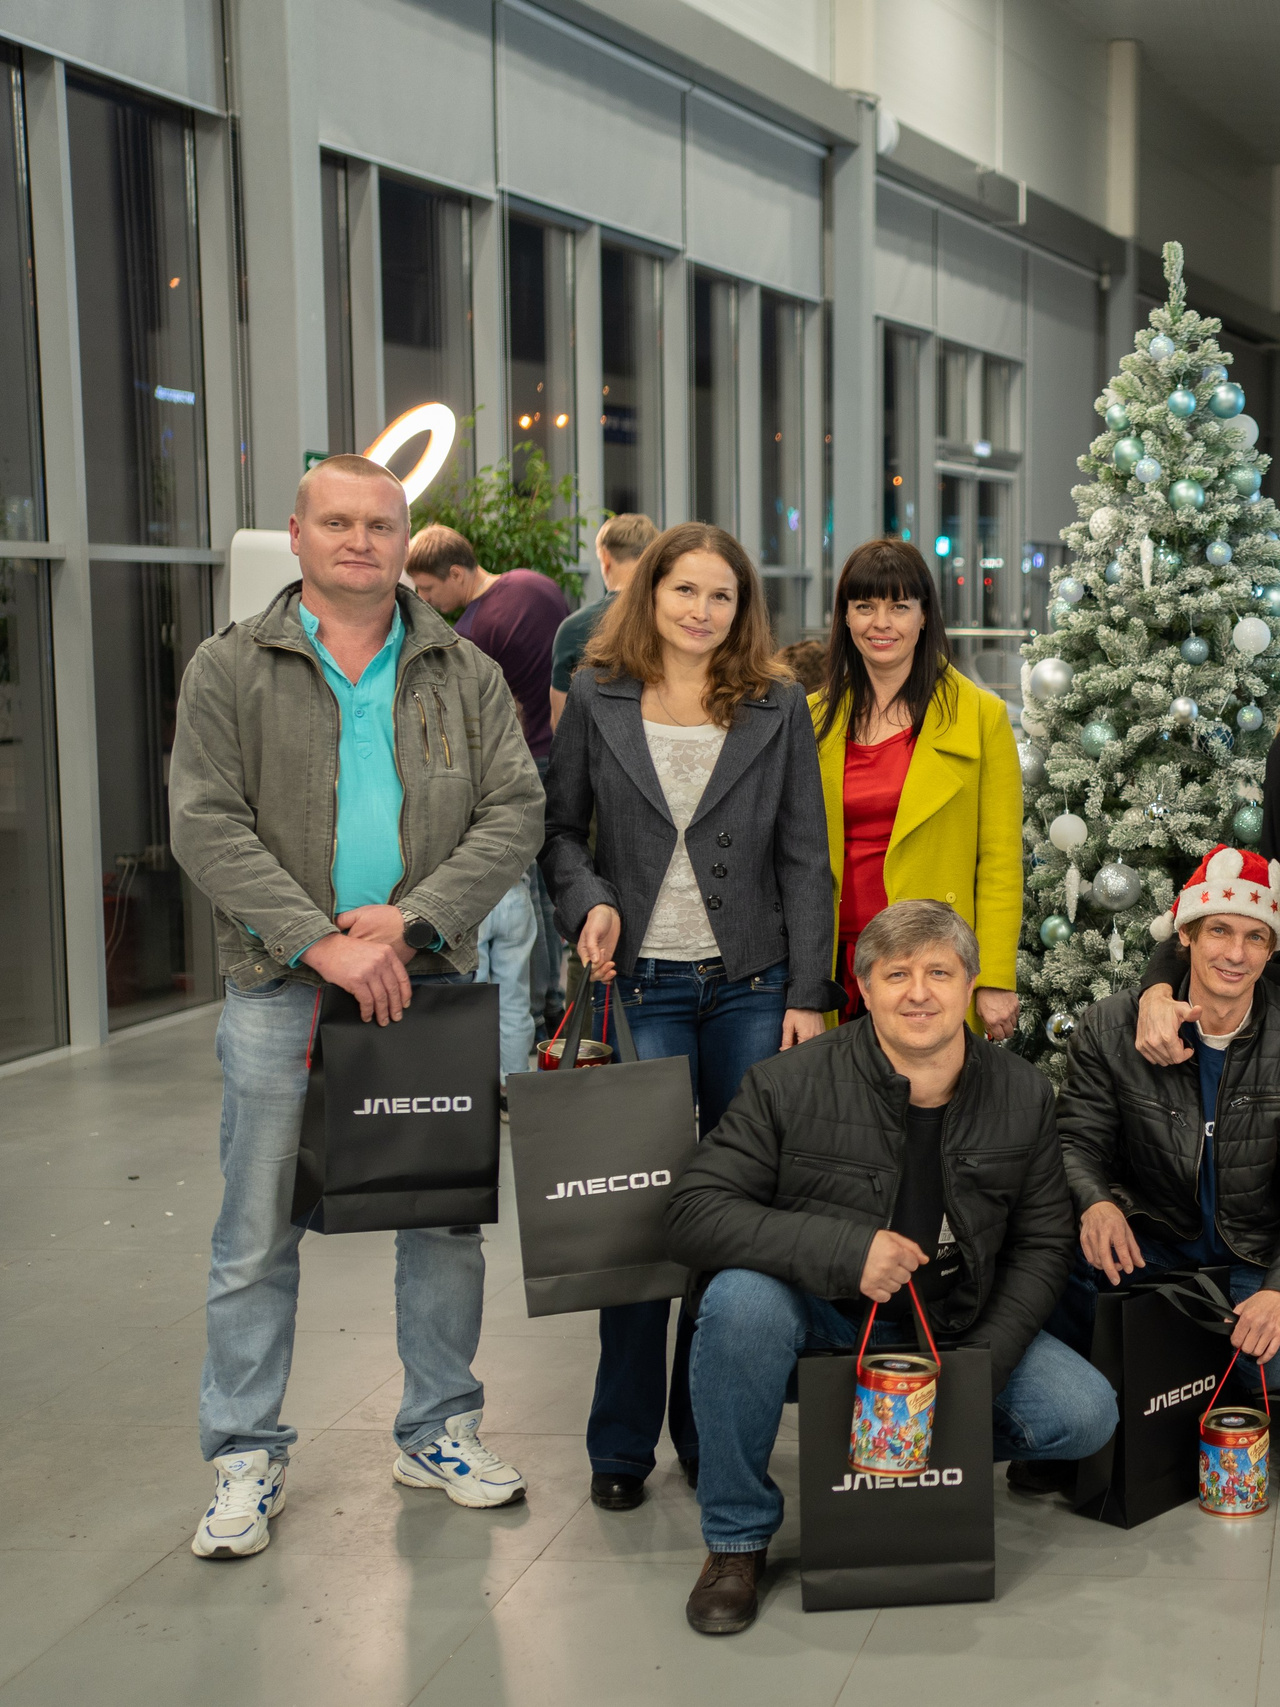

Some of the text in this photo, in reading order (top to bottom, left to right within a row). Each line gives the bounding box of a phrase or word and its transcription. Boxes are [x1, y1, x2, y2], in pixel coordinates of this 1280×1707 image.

[353, 1095, 472, 1115] JAECOO
[545, 1169, 672, 1200] JAECOO
[1143, 1374, 1216, 1416] JAECOO
